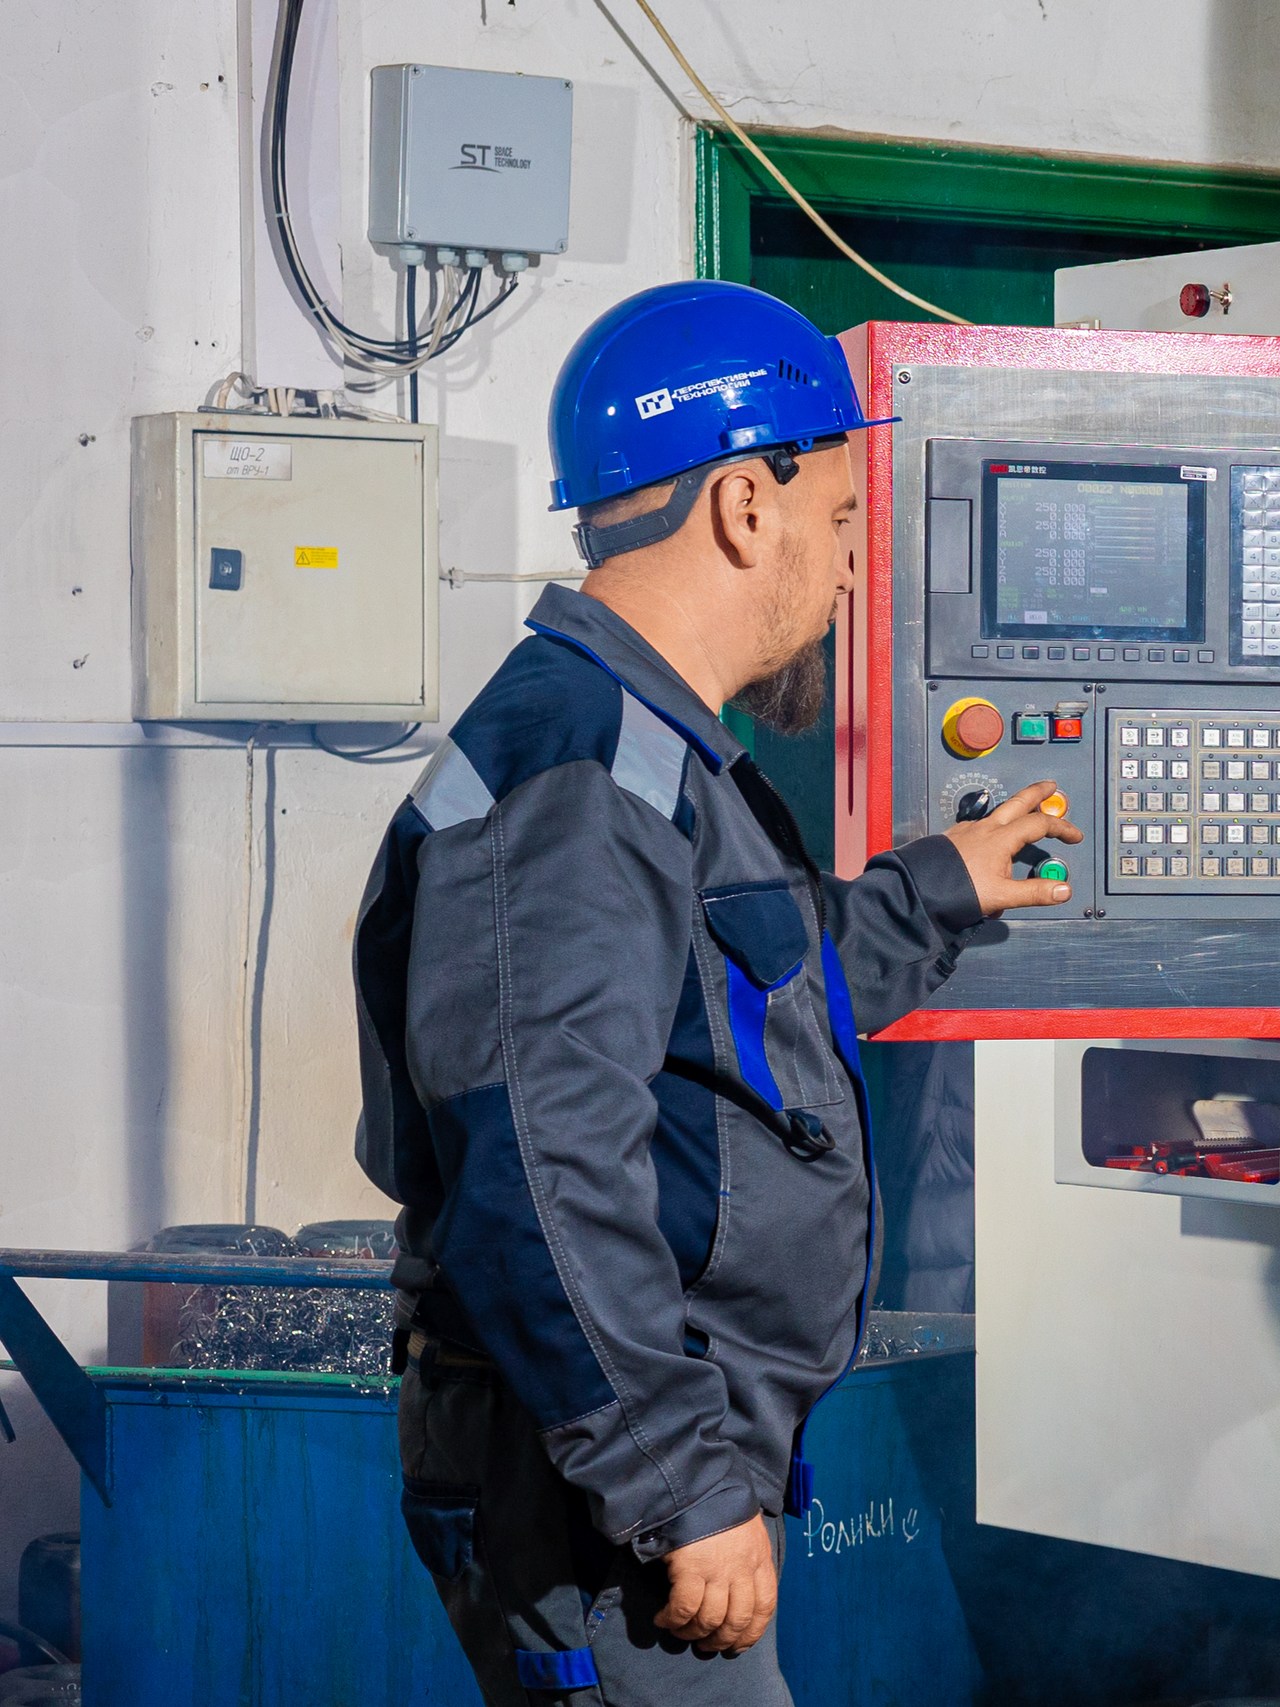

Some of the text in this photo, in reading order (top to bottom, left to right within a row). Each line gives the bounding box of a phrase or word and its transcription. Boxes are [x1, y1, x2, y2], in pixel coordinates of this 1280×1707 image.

[461, 144, 491, 166] ST
[494, 146, 512, 157] SPACE
[494, 157, 532, 170] TECHNOLOGY
[674, 368, 768, 396] ПЕРСПЕКТИВНЫЕ
[230, 446, 266, 462] ЩО-2
[226, 464, 270, 476] от ВРУ-1
[1035, 502, 1085, 512] 250.000
[1049, 512, 1085, 521] 0.000
[1035, 521, 1085, 530] 250.000
[1049, 530, 1085, 540] 0.000
[1035, 548, 1085, 558] 250.000
[1049, 558, 1085, 567] 0.000
[1035, 567, 1085, 576] 250.000
[1049, 576, 1085, 585] 0.000
